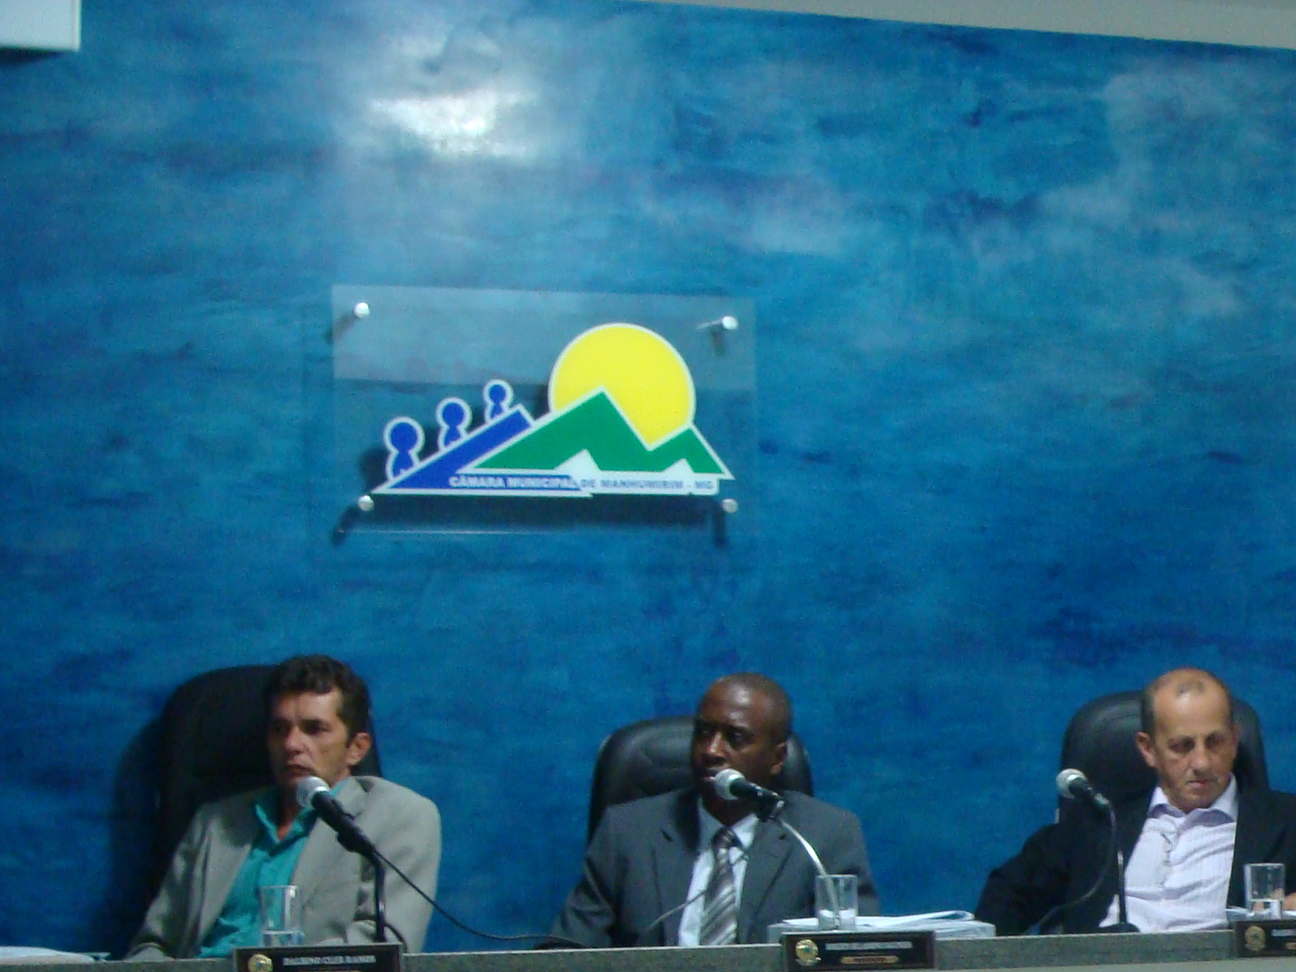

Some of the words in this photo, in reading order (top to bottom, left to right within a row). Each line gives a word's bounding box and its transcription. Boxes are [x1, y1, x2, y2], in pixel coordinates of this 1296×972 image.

[448, 474, 506, 488] CÂMARA
[507, 475, 580, 489] MUNICIPAL
[580, 478, 596, 488] DE
